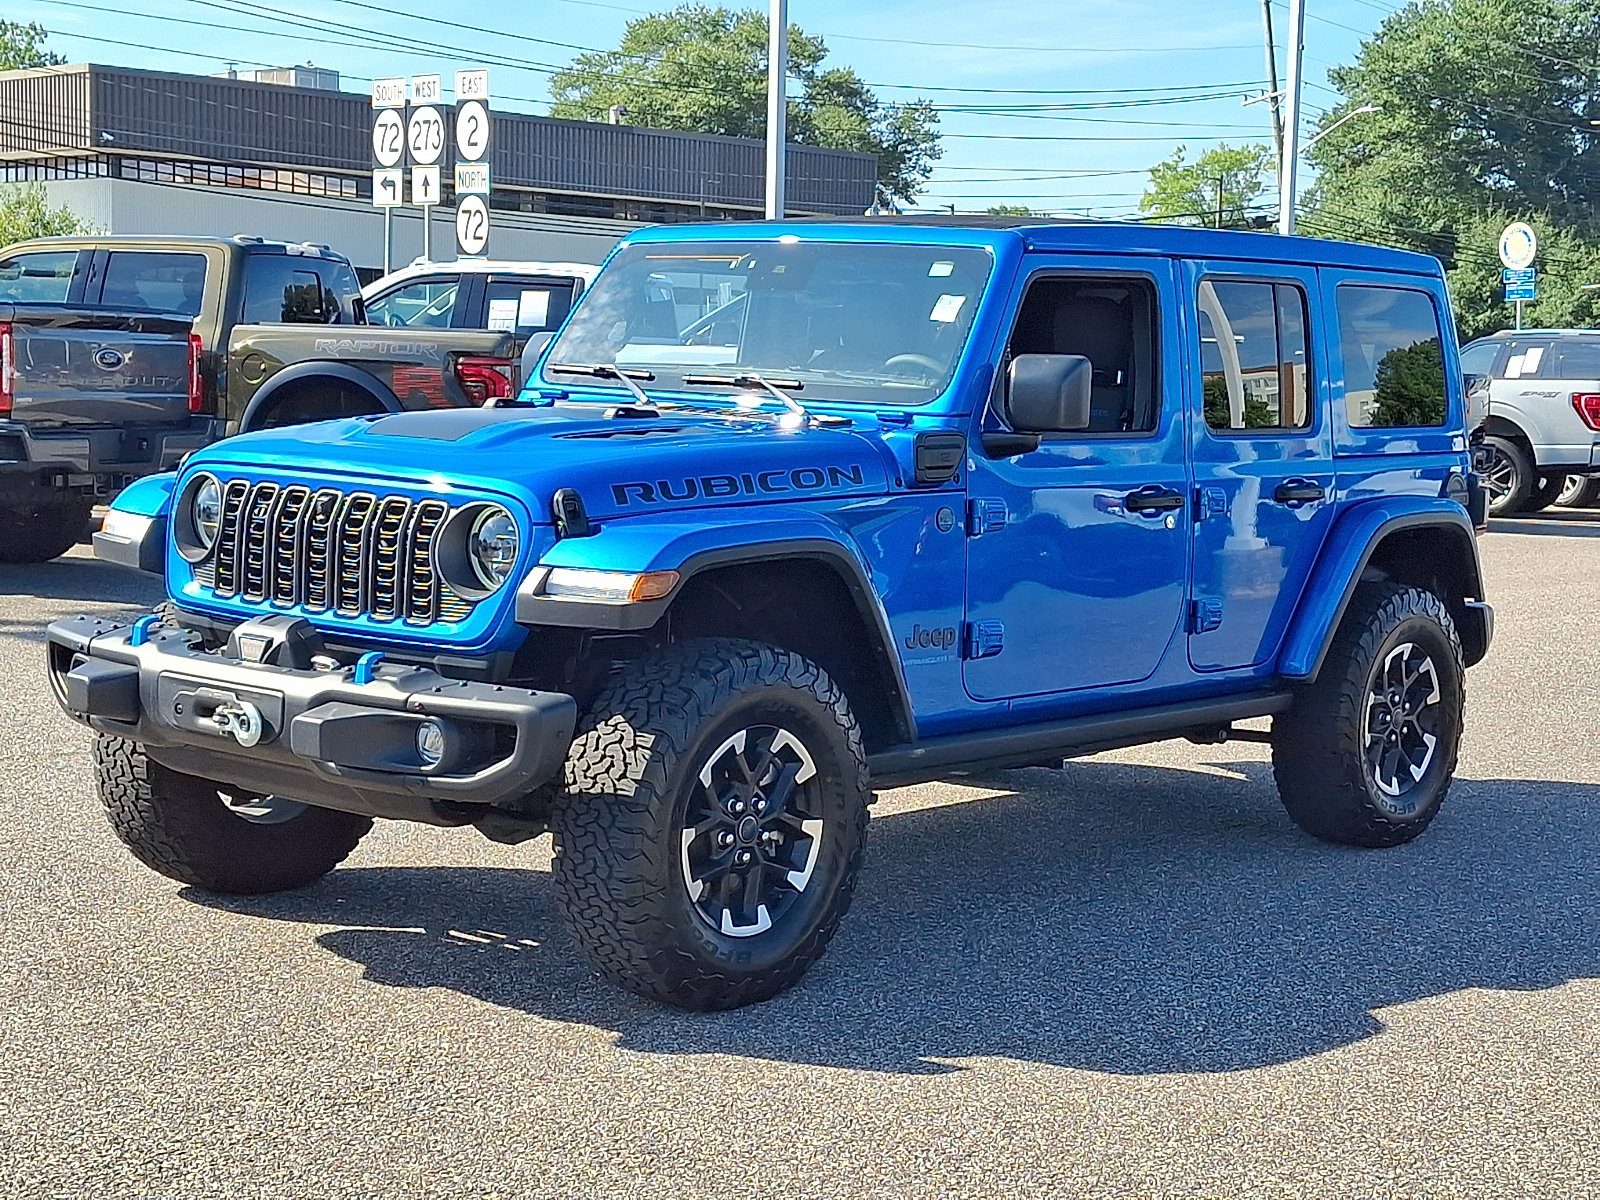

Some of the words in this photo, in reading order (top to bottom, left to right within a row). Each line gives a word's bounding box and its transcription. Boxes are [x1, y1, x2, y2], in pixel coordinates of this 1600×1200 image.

[375, 84, 403, 101] SOUTH
[415, 80, 436, 98] WEST
[462, 76, 482, 94] EAST
[378, 122, 400, 153] 72
[412, 119, 441, 151] 273
[467, 115, 479, 147] 2
[458, 170, 486, 189] NORTH
[461, 209, 484, 241] 72
[314, 338, 441, 361] RAPTOR
[122, 375, 184, 387] DUTY
[610, 463, 865, 507] RUBICON
[904, 624, 957, 650] Jeep
